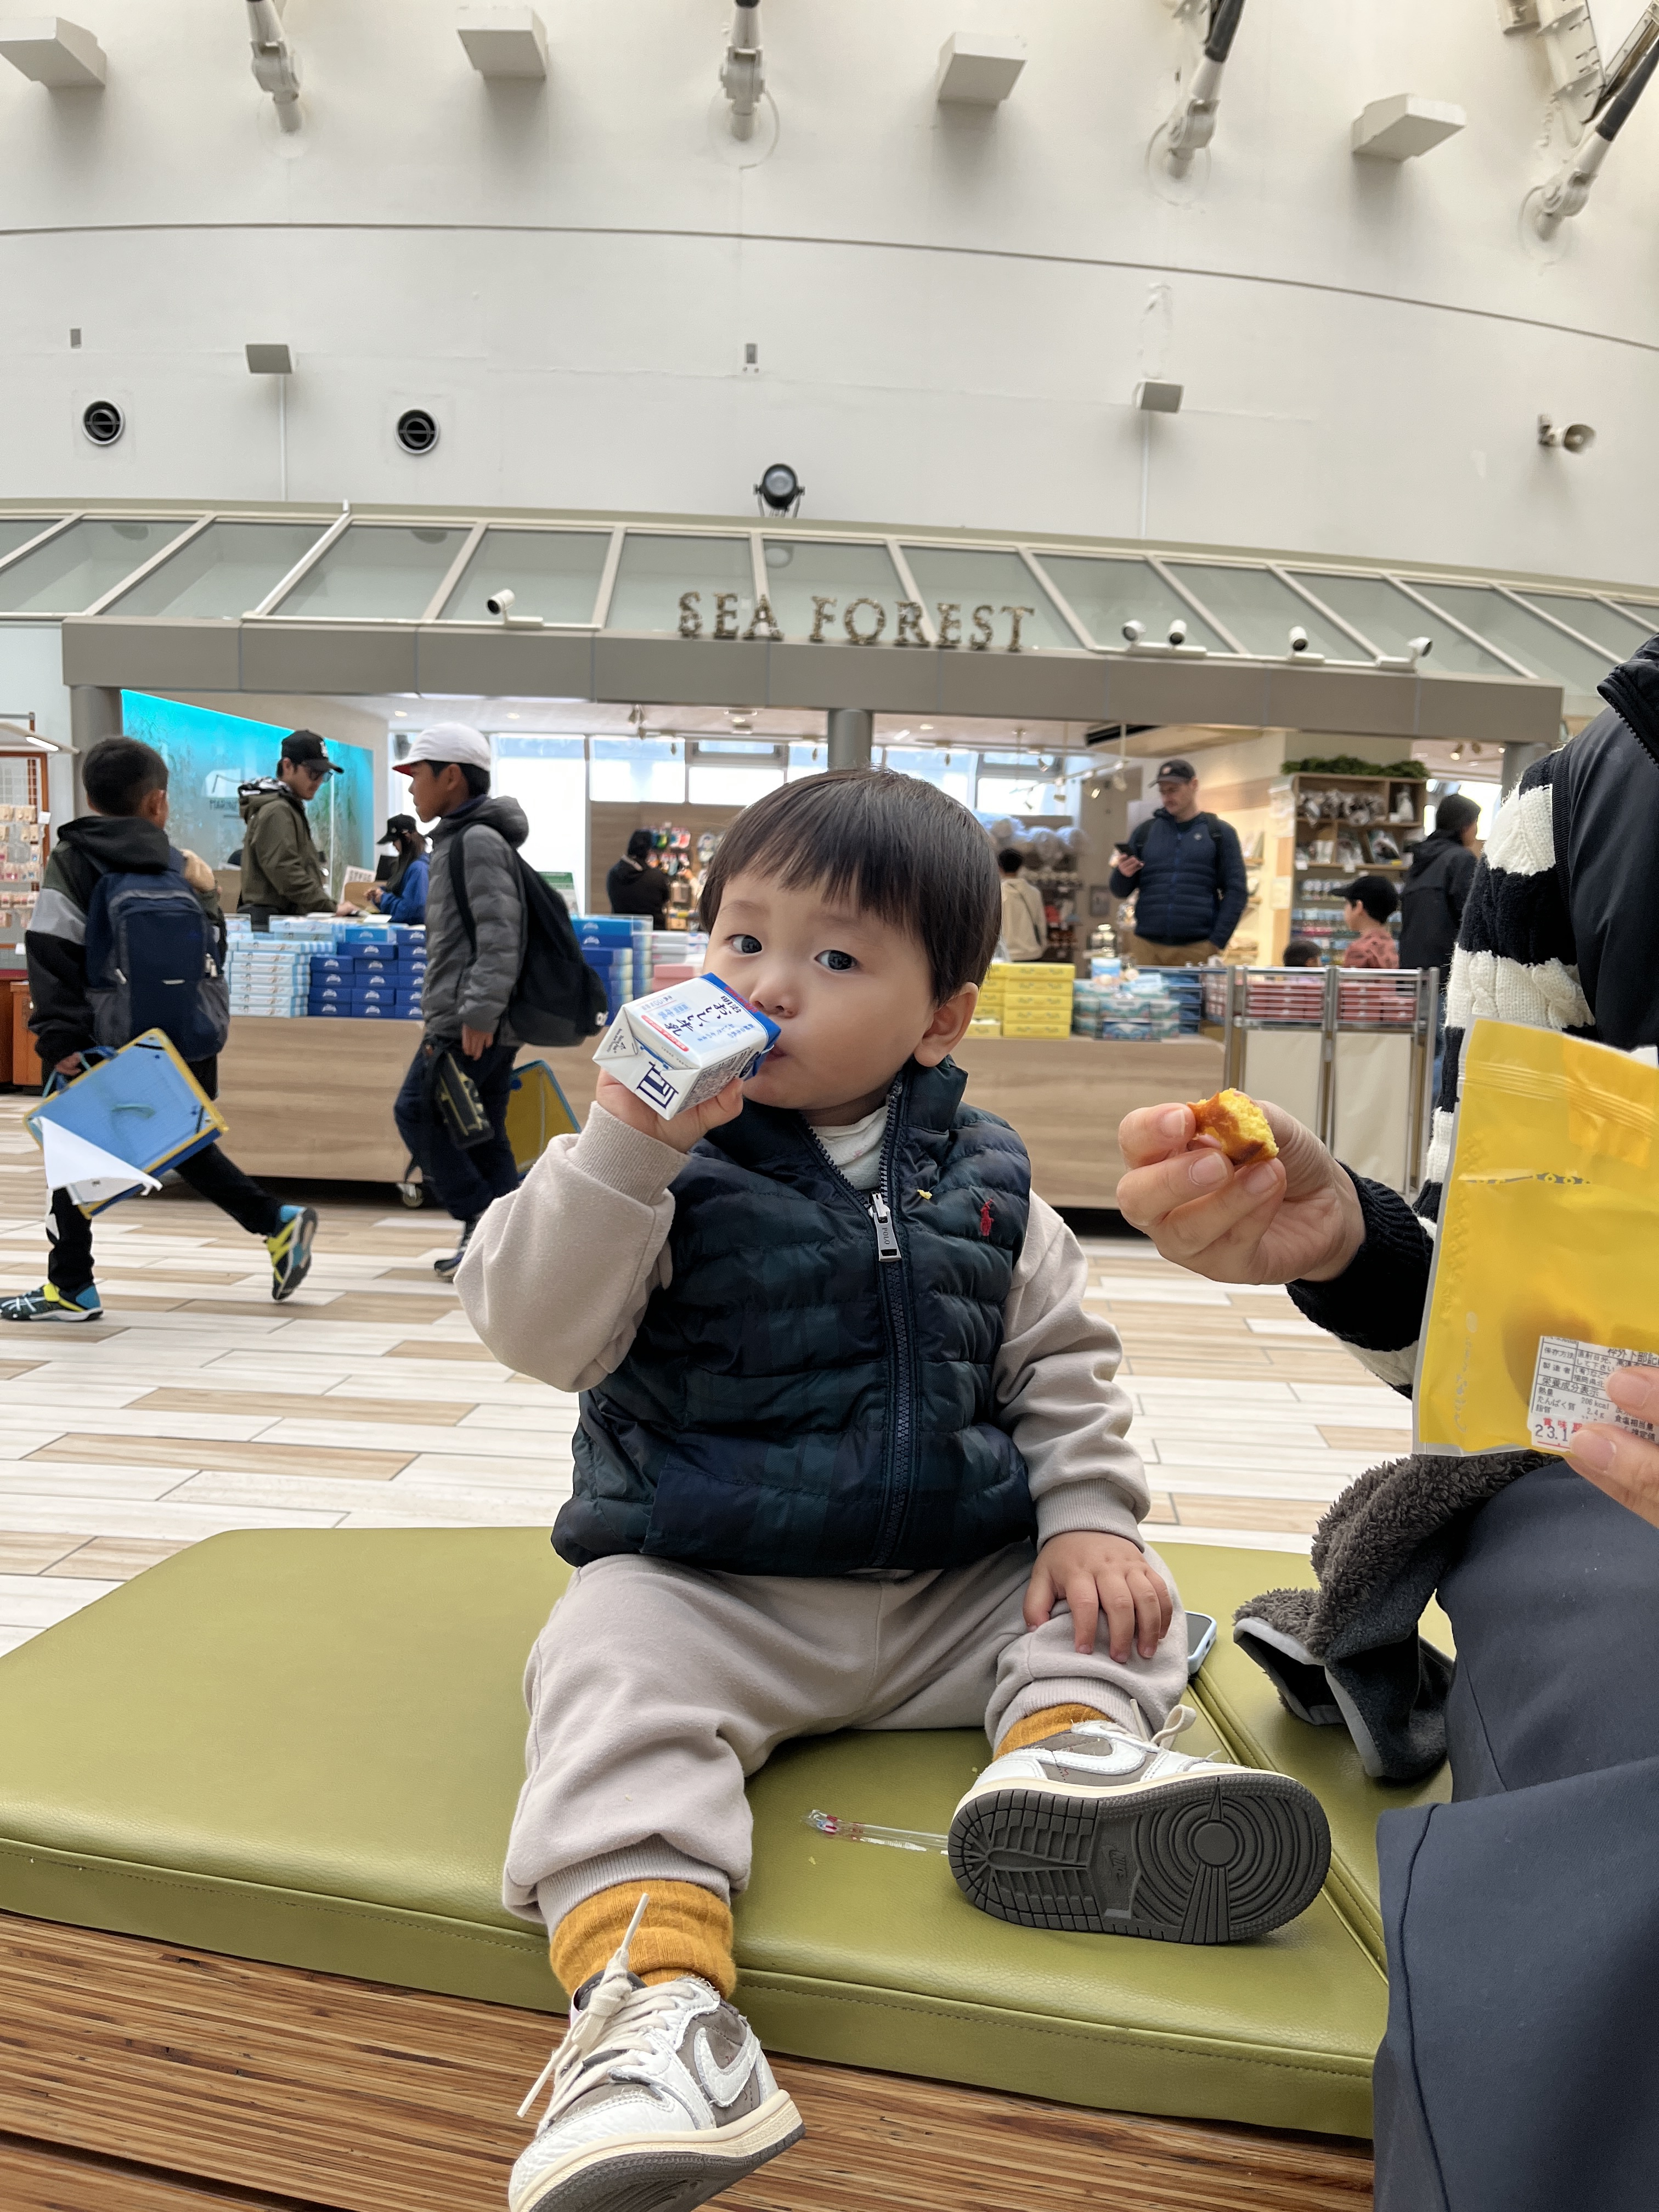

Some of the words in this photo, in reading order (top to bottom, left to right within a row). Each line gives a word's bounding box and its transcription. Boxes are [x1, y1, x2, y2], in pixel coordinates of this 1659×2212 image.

[678, 591, 785, 641] SEA
[809, 595, 1036, 652] FOREST
[720, 995, 742, 1013] 明治
[664, 1002, 732, 1037] おいしい牛乳
[882, 1227, 890, 1245] POLO
[1544, 1346, 1575, 1359] 保存方法
[1543, 1362, 1571, 1374] 製造者
[1538, 1386, 1554, 1397] 熱量
[1542, 1376, 1599, 1397] 栄養成分表示
[1537, 1396, 1576, 1412] たんぱく質
[1581, 1397, 1593, 1406] 206
[1594, 1400, 1610, 1410] kcal
[1615, 1415, 1654, 1432] 食塩相当量
